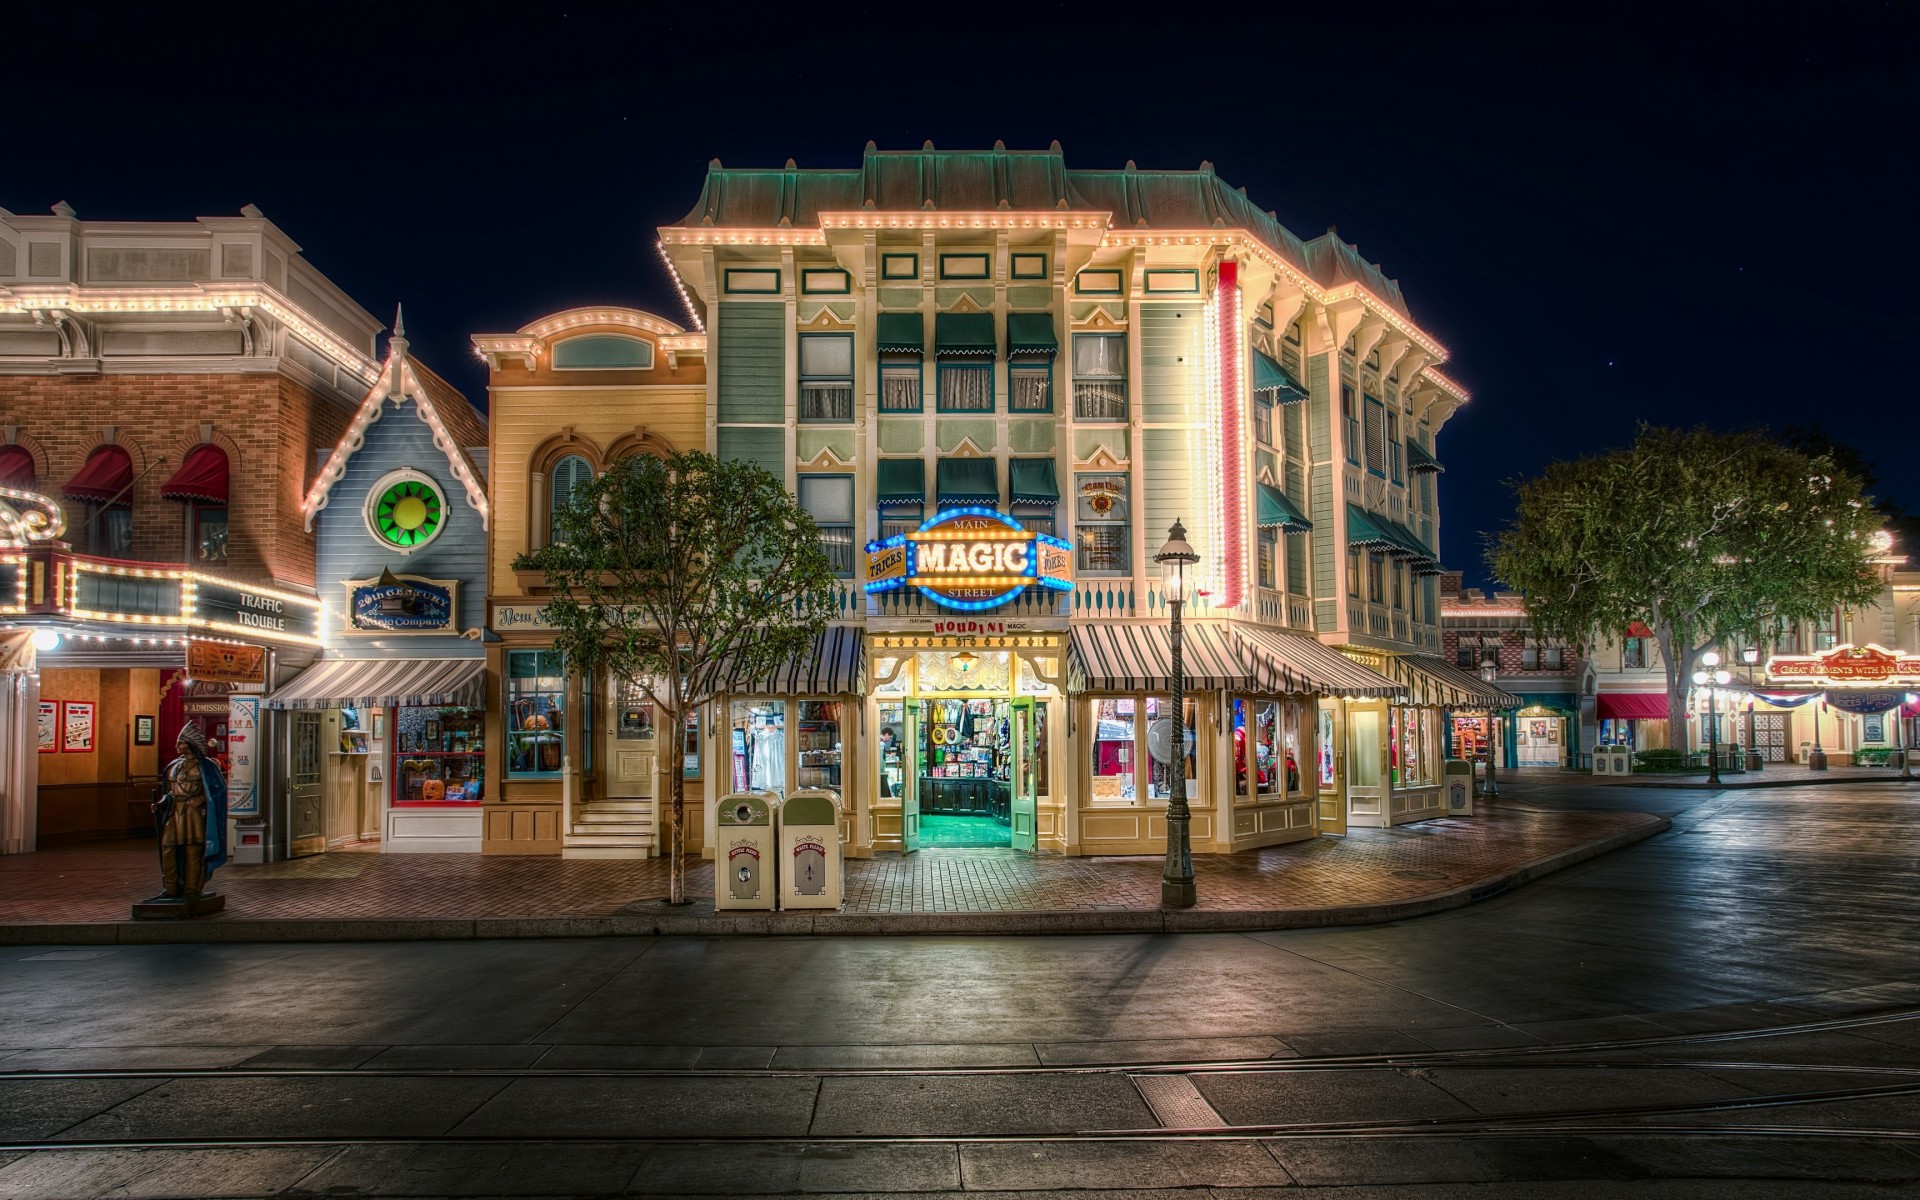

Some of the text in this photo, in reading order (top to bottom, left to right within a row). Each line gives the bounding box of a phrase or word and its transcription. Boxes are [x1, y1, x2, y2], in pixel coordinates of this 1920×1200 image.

[953, 520, 989, 530] MAIN
[869, 551, 903, 578] TRICKS
[916, 542, 1029, 573] MAGIC
[358, 592, 385, 609] 20th
[948, 588, 996, 598] STREET
[240, 592, 283, 613] TRAFFIC
[238, 610, 285, 632] TROUBLE
[394, 617, 448, 627] Company
[1780, 665, 1809, 675] GREAT
